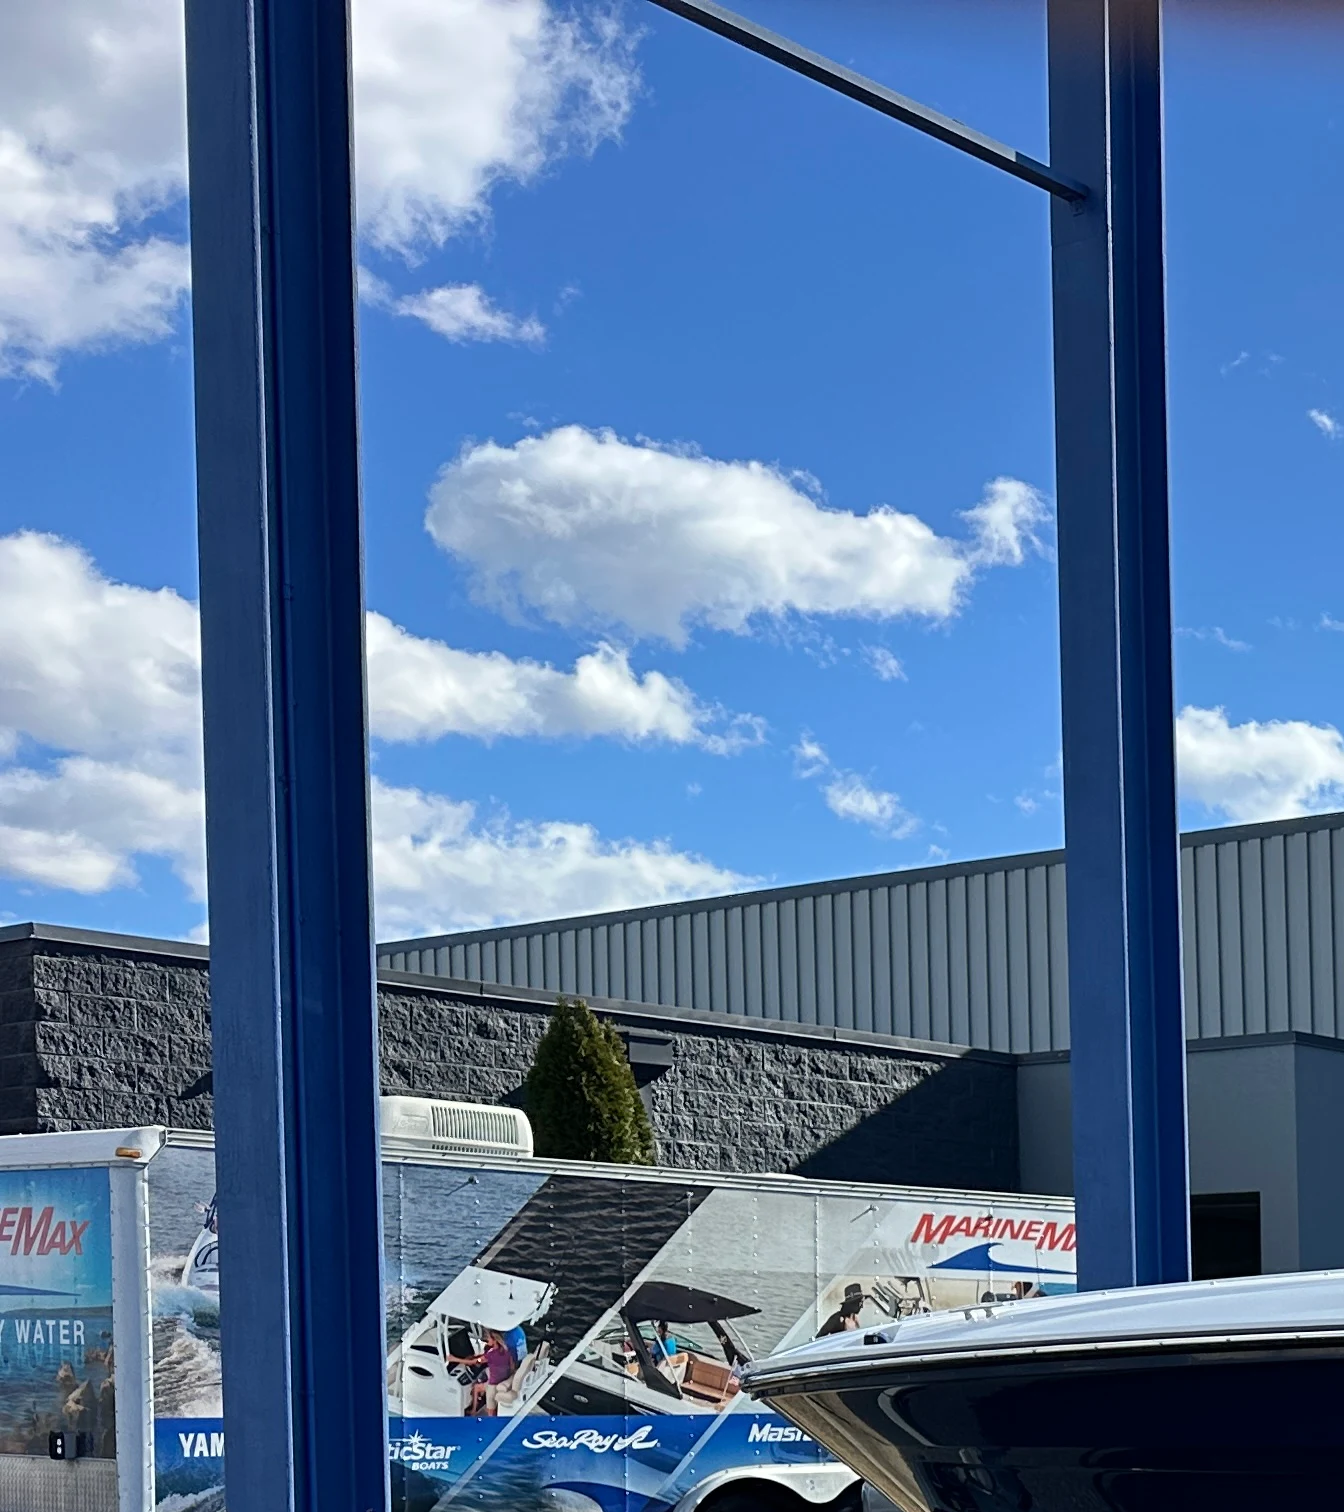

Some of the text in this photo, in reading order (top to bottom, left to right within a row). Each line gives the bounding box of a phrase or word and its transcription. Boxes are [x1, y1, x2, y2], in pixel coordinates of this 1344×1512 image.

[0, 1206, 90, 1256] EMAX
[910, 1213, 1077, 1252] MARINEM
[15, 1319, 86, 1346] WATER
[178, 1432, 225, 1458] YAM
[389, 1442, 457, 1461] ticStar
[522, 1429, 618, 1454] Sea Ray
[411, 1461, 449, 1471] BOATS
